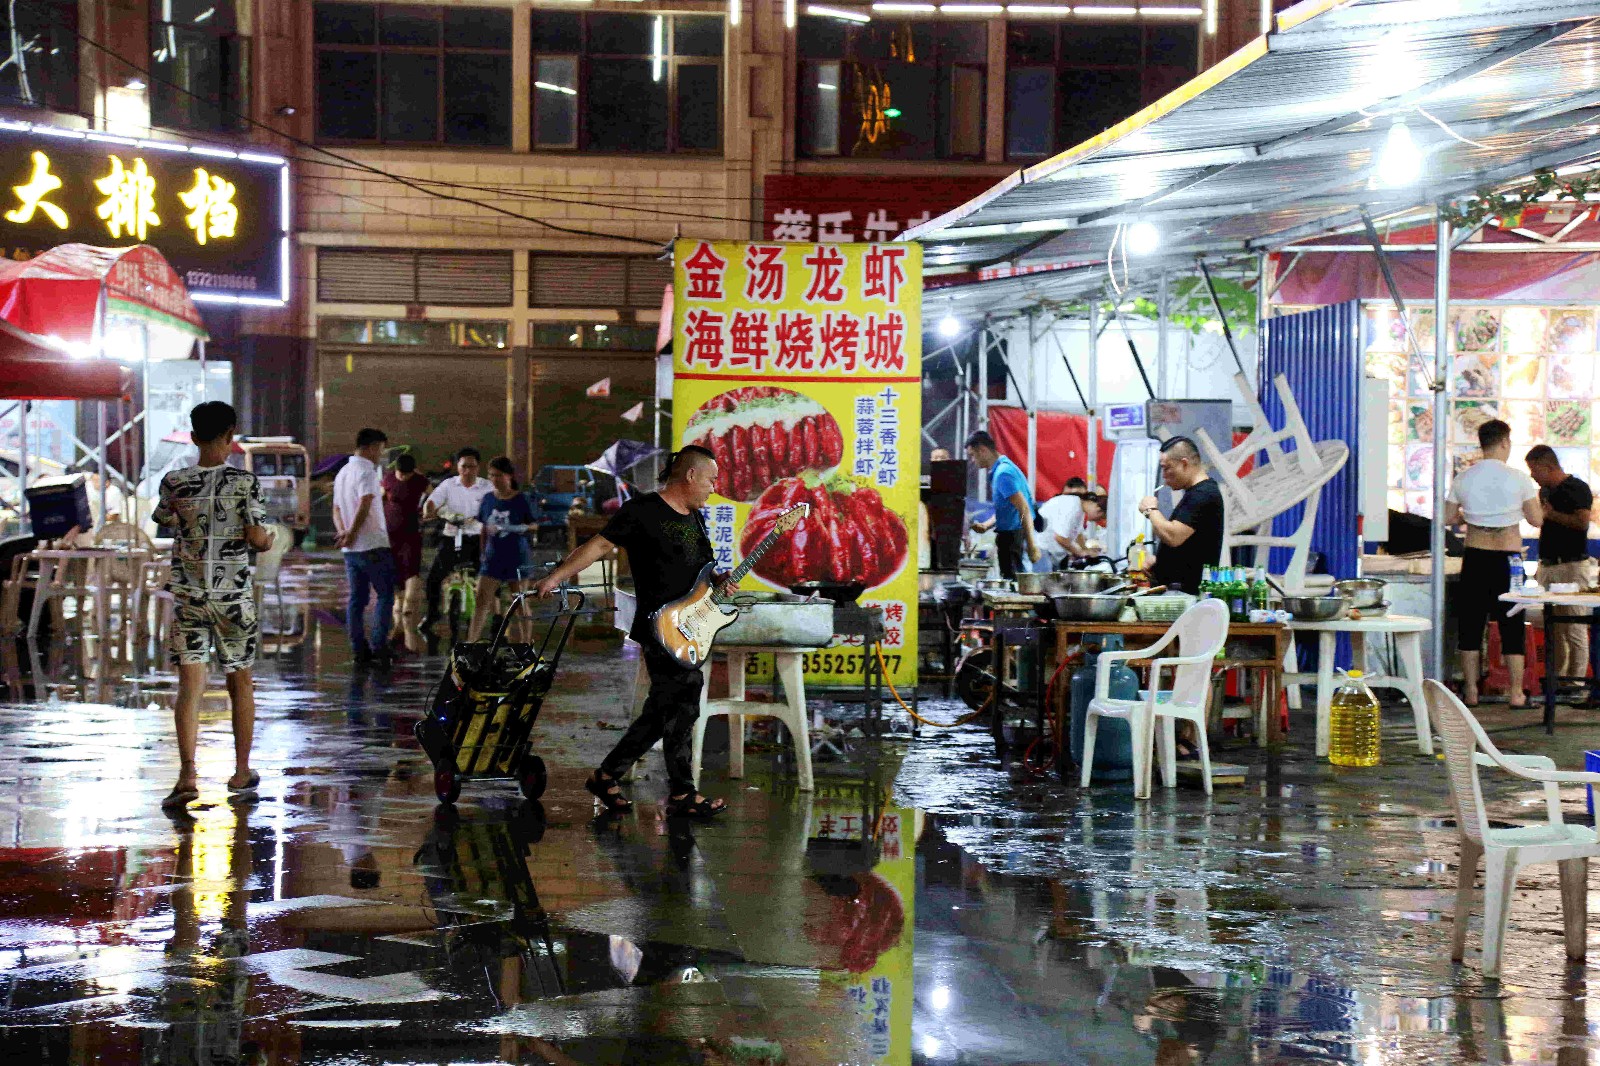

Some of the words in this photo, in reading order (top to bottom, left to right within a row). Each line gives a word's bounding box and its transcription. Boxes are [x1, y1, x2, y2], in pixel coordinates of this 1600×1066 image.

[4, 150, 239, 246] 大排档
[773, 207, 931, 242] 蔡氏牛
[685, 242, 905, 303] 金汤龙虾
[684, 310, 905, 371] 海鲜烧烤城
[856, 397, 875, 475] 蒜蓉拌虾
[878, 388, 897, 485] 十三香龙虾
[866, 603, 904, 622] 烤
